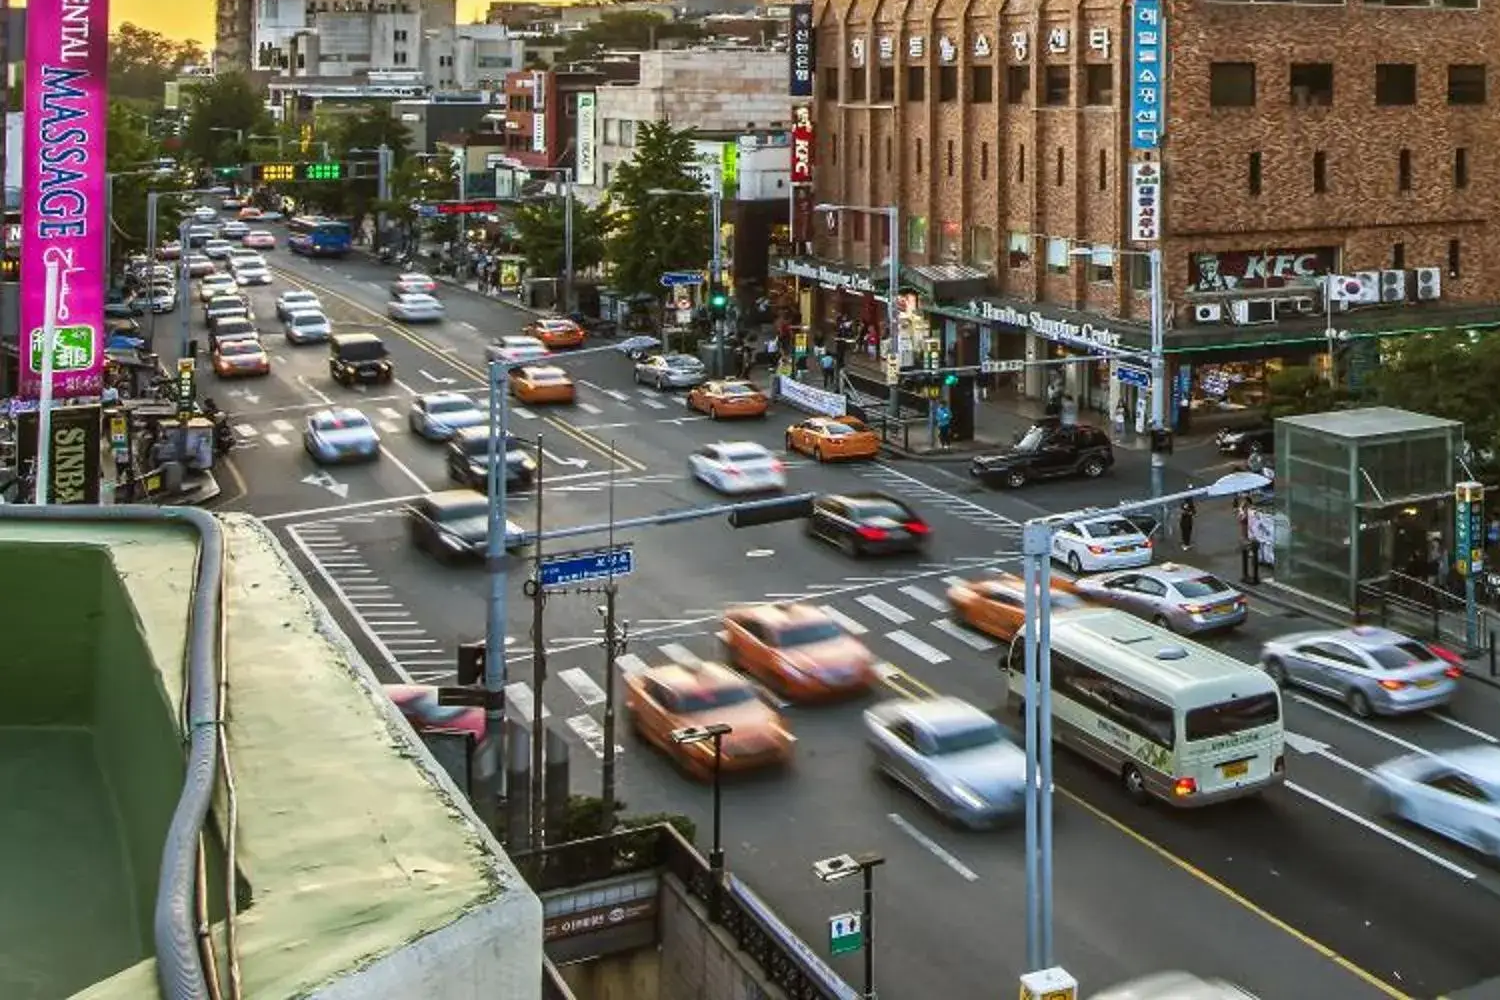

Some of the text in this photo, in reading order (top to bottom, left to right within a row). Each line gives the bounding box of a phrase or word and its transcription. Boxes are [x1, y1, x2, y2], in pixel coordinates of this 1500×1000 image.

[38, 65, 91, 240] MASSAGE
[1243, 253, 1317, 279] KFC
[982, 300, 1121, 346] Hamilton Shopping Center
